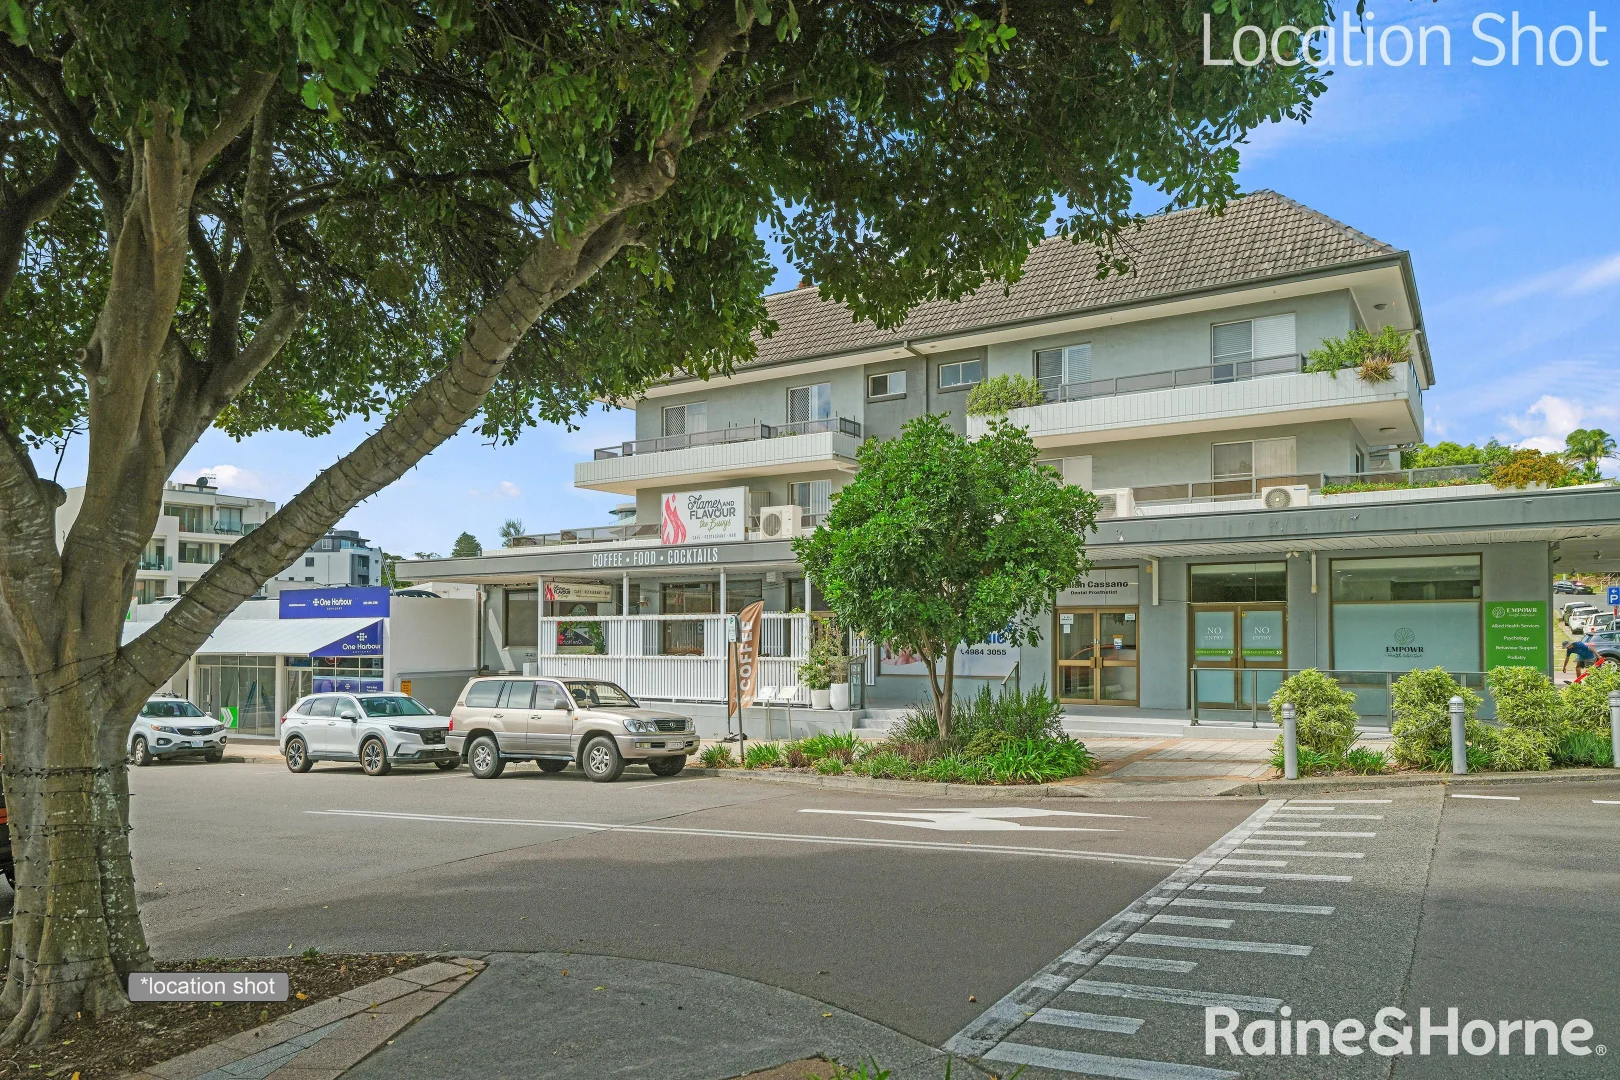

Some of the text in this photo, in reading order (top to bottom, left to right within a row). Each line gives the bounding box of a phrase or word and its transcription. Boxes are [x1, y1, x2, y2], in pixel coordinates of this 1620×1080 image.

[688, 494, 722, 511] Flames
[690, 507, 736, 520] FLAVOUR
[592, 548, 718, 567] COFFEE FOOD COCKTAILS
[320, 598, 331, 606] One
[331, 598, 353, 606] Harbour
[1610, 595, 1619, 604] P
[1207, 626, 1222, 634] NO
[1254, 626, 1270, 634] NO
[342, 643, 356, 651] One
[739, 621, 753, 691] COFFEE
